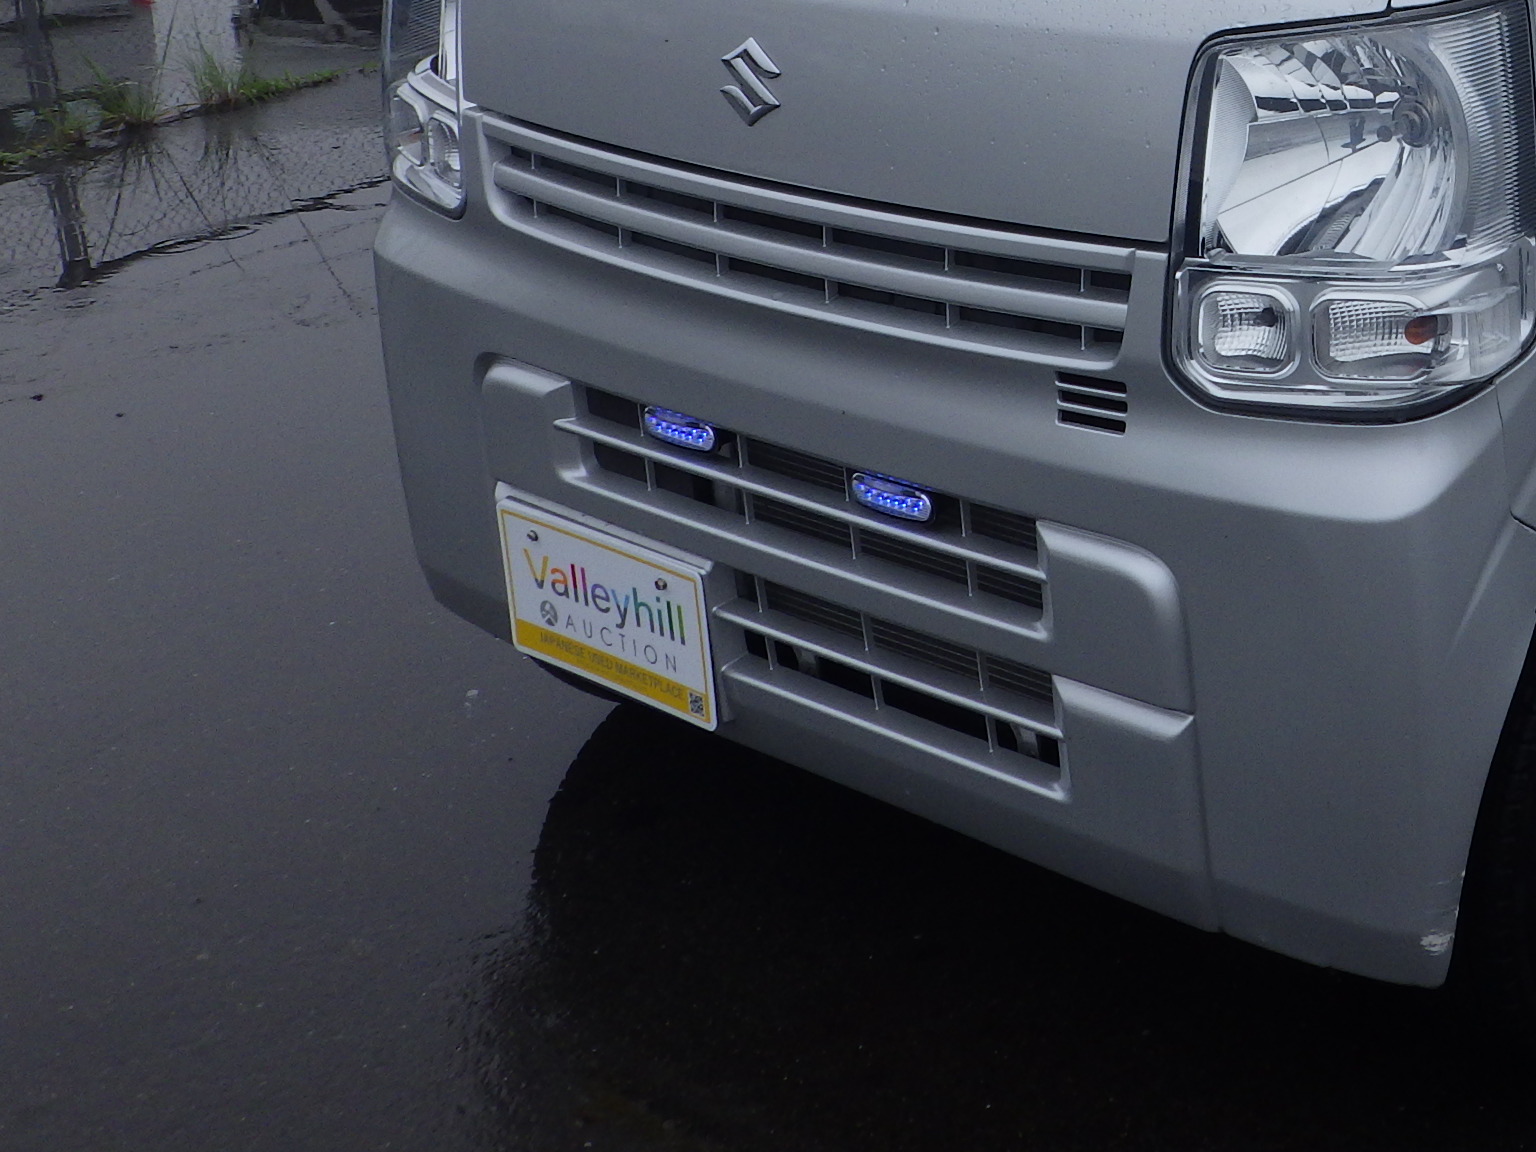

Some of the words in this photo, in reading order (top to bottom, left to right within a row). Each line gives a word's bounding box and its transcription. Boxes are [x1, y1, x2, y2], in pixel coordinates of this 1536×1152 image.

[523, 548, 686, 646] Valleyhill
[565, 615, 678, 673] AUCTION
[615, 662, 682, 698] MARKETPLACE
